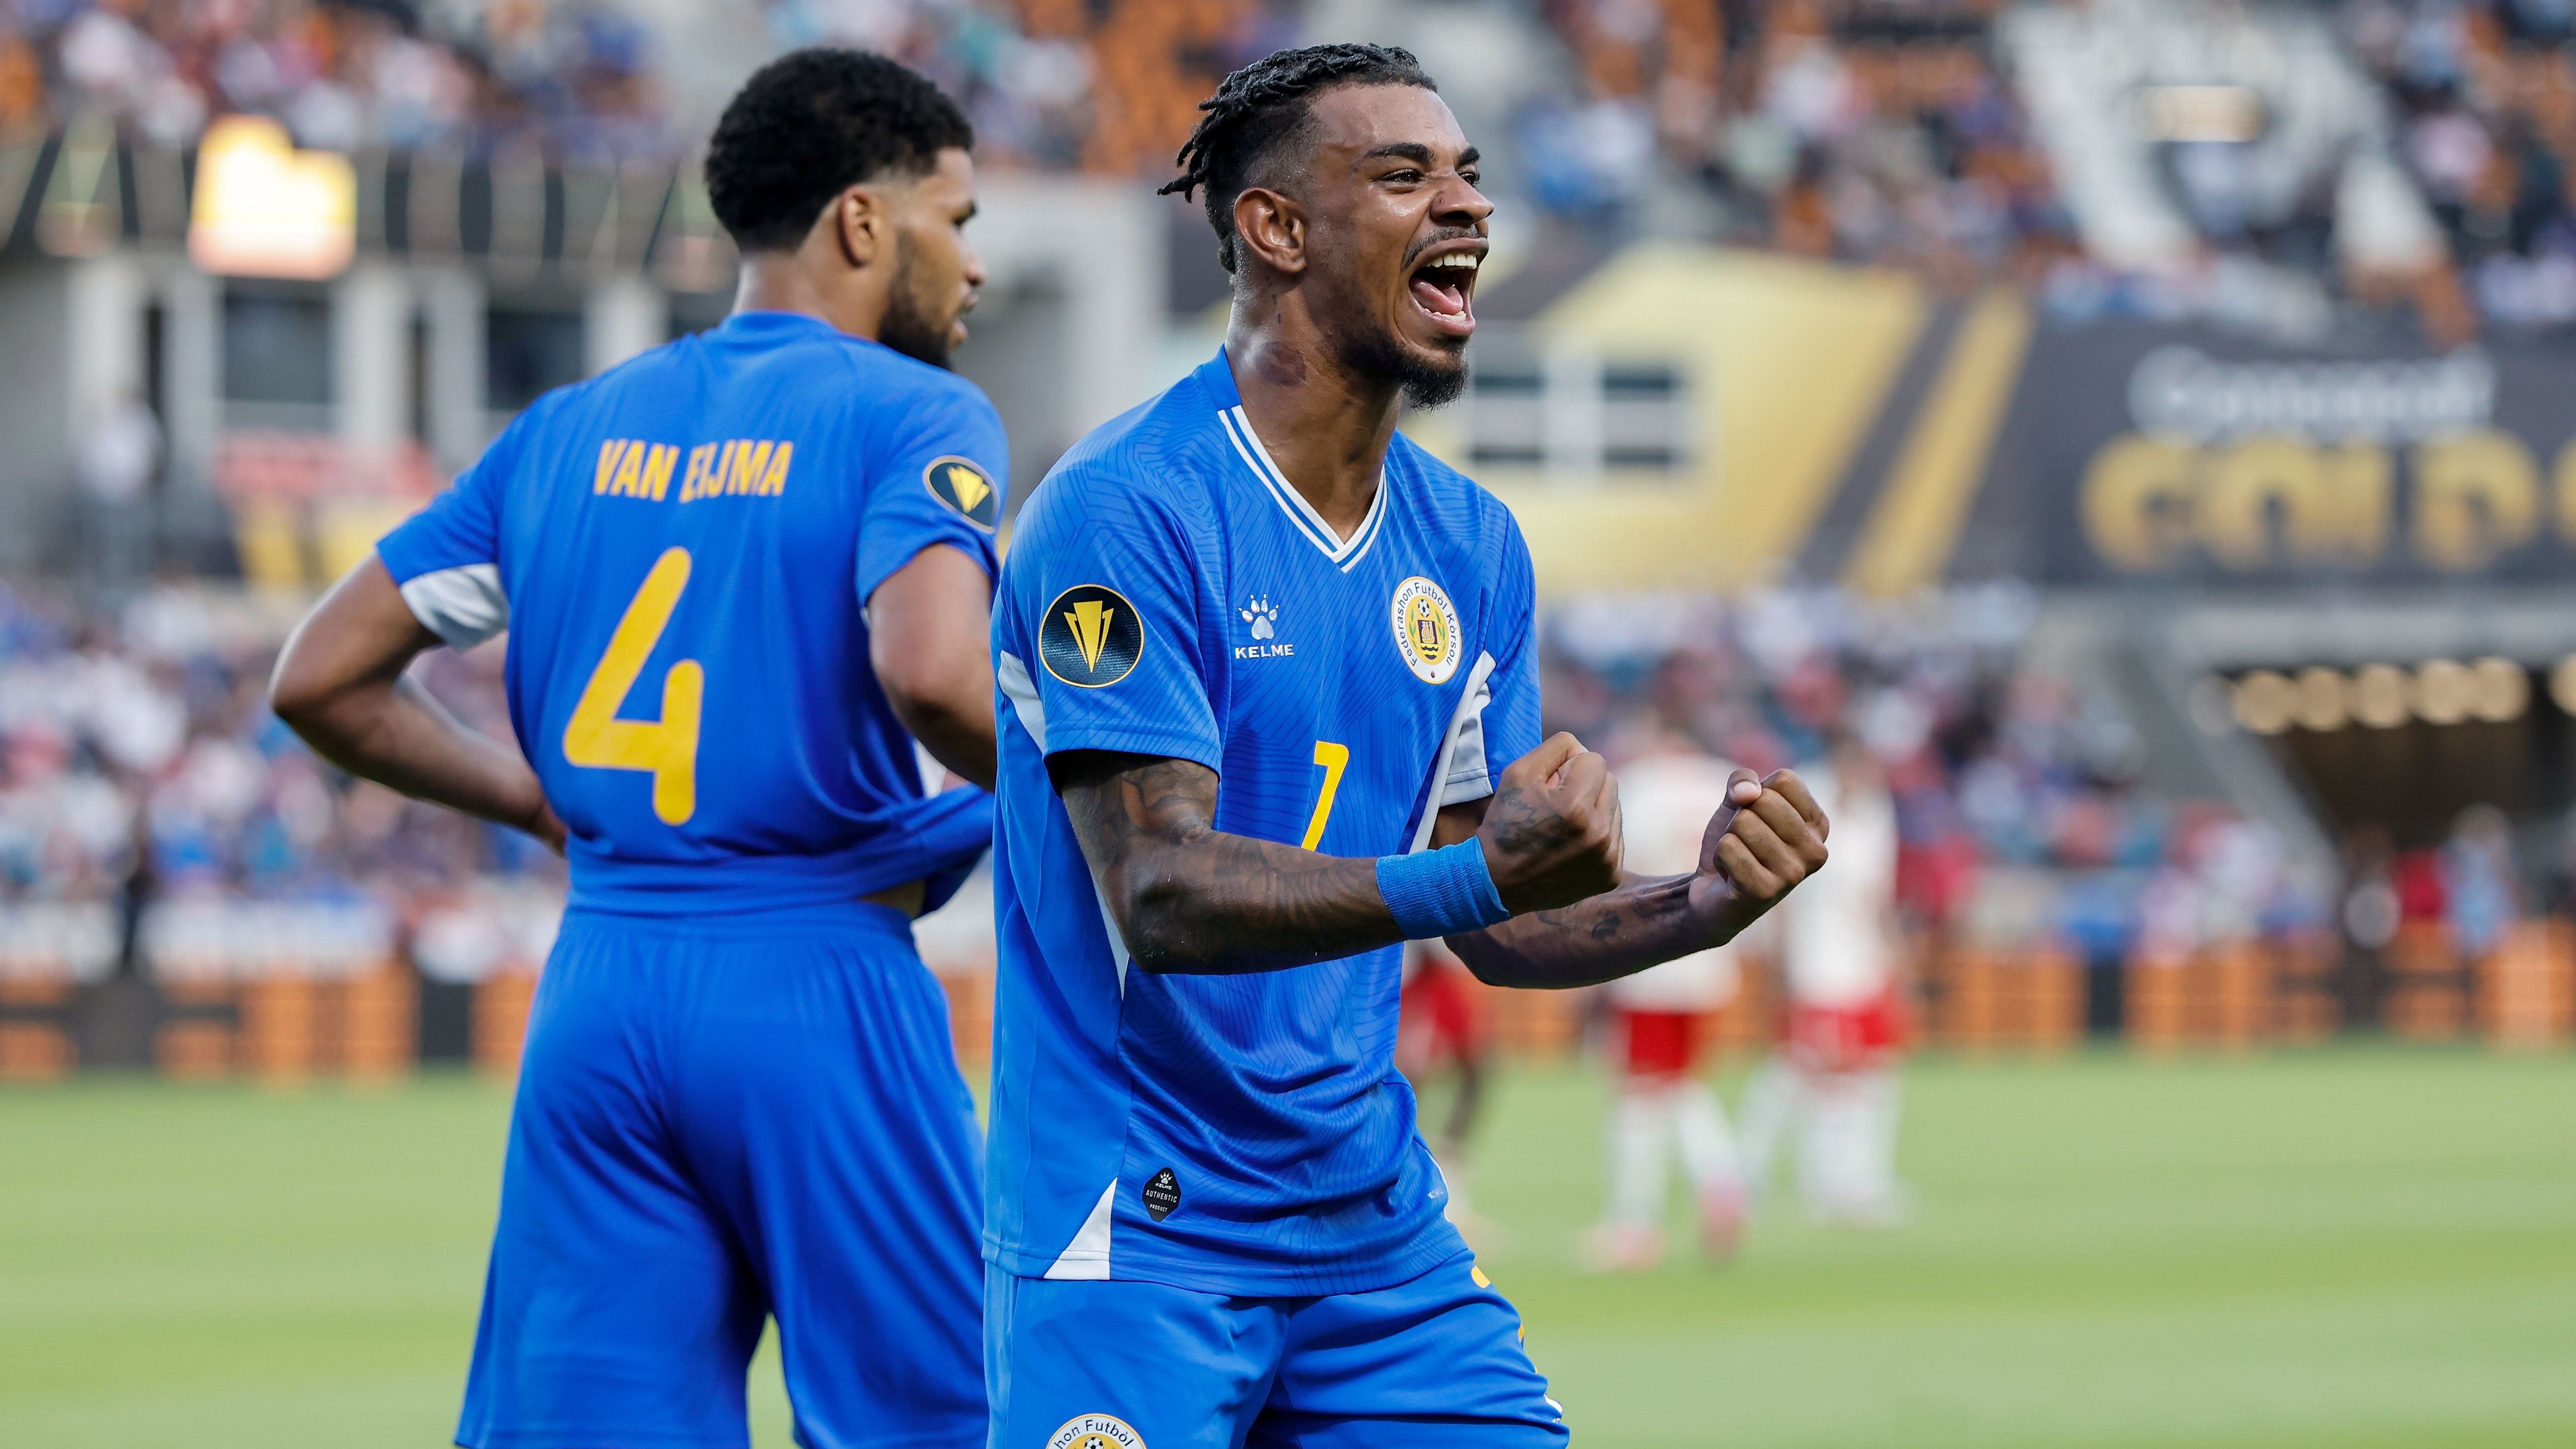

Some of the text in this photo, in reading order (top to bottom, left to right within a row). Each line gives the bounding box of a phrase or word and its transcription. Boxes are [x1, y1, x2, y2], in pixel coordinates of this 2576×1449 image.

[593, 438, 794, 504] VAN EIJMA
[1235, 644, 1294, 659] KELME
[1397, 587, 1417, 667] Federashon
[563, 547, 704, 826] 4
[1301, 741, 1349, 852] 7
[1145, 1189, 1177, 1203] AUTHENTIC
[1150, 1203, 1168, 1212] PRODUCT
